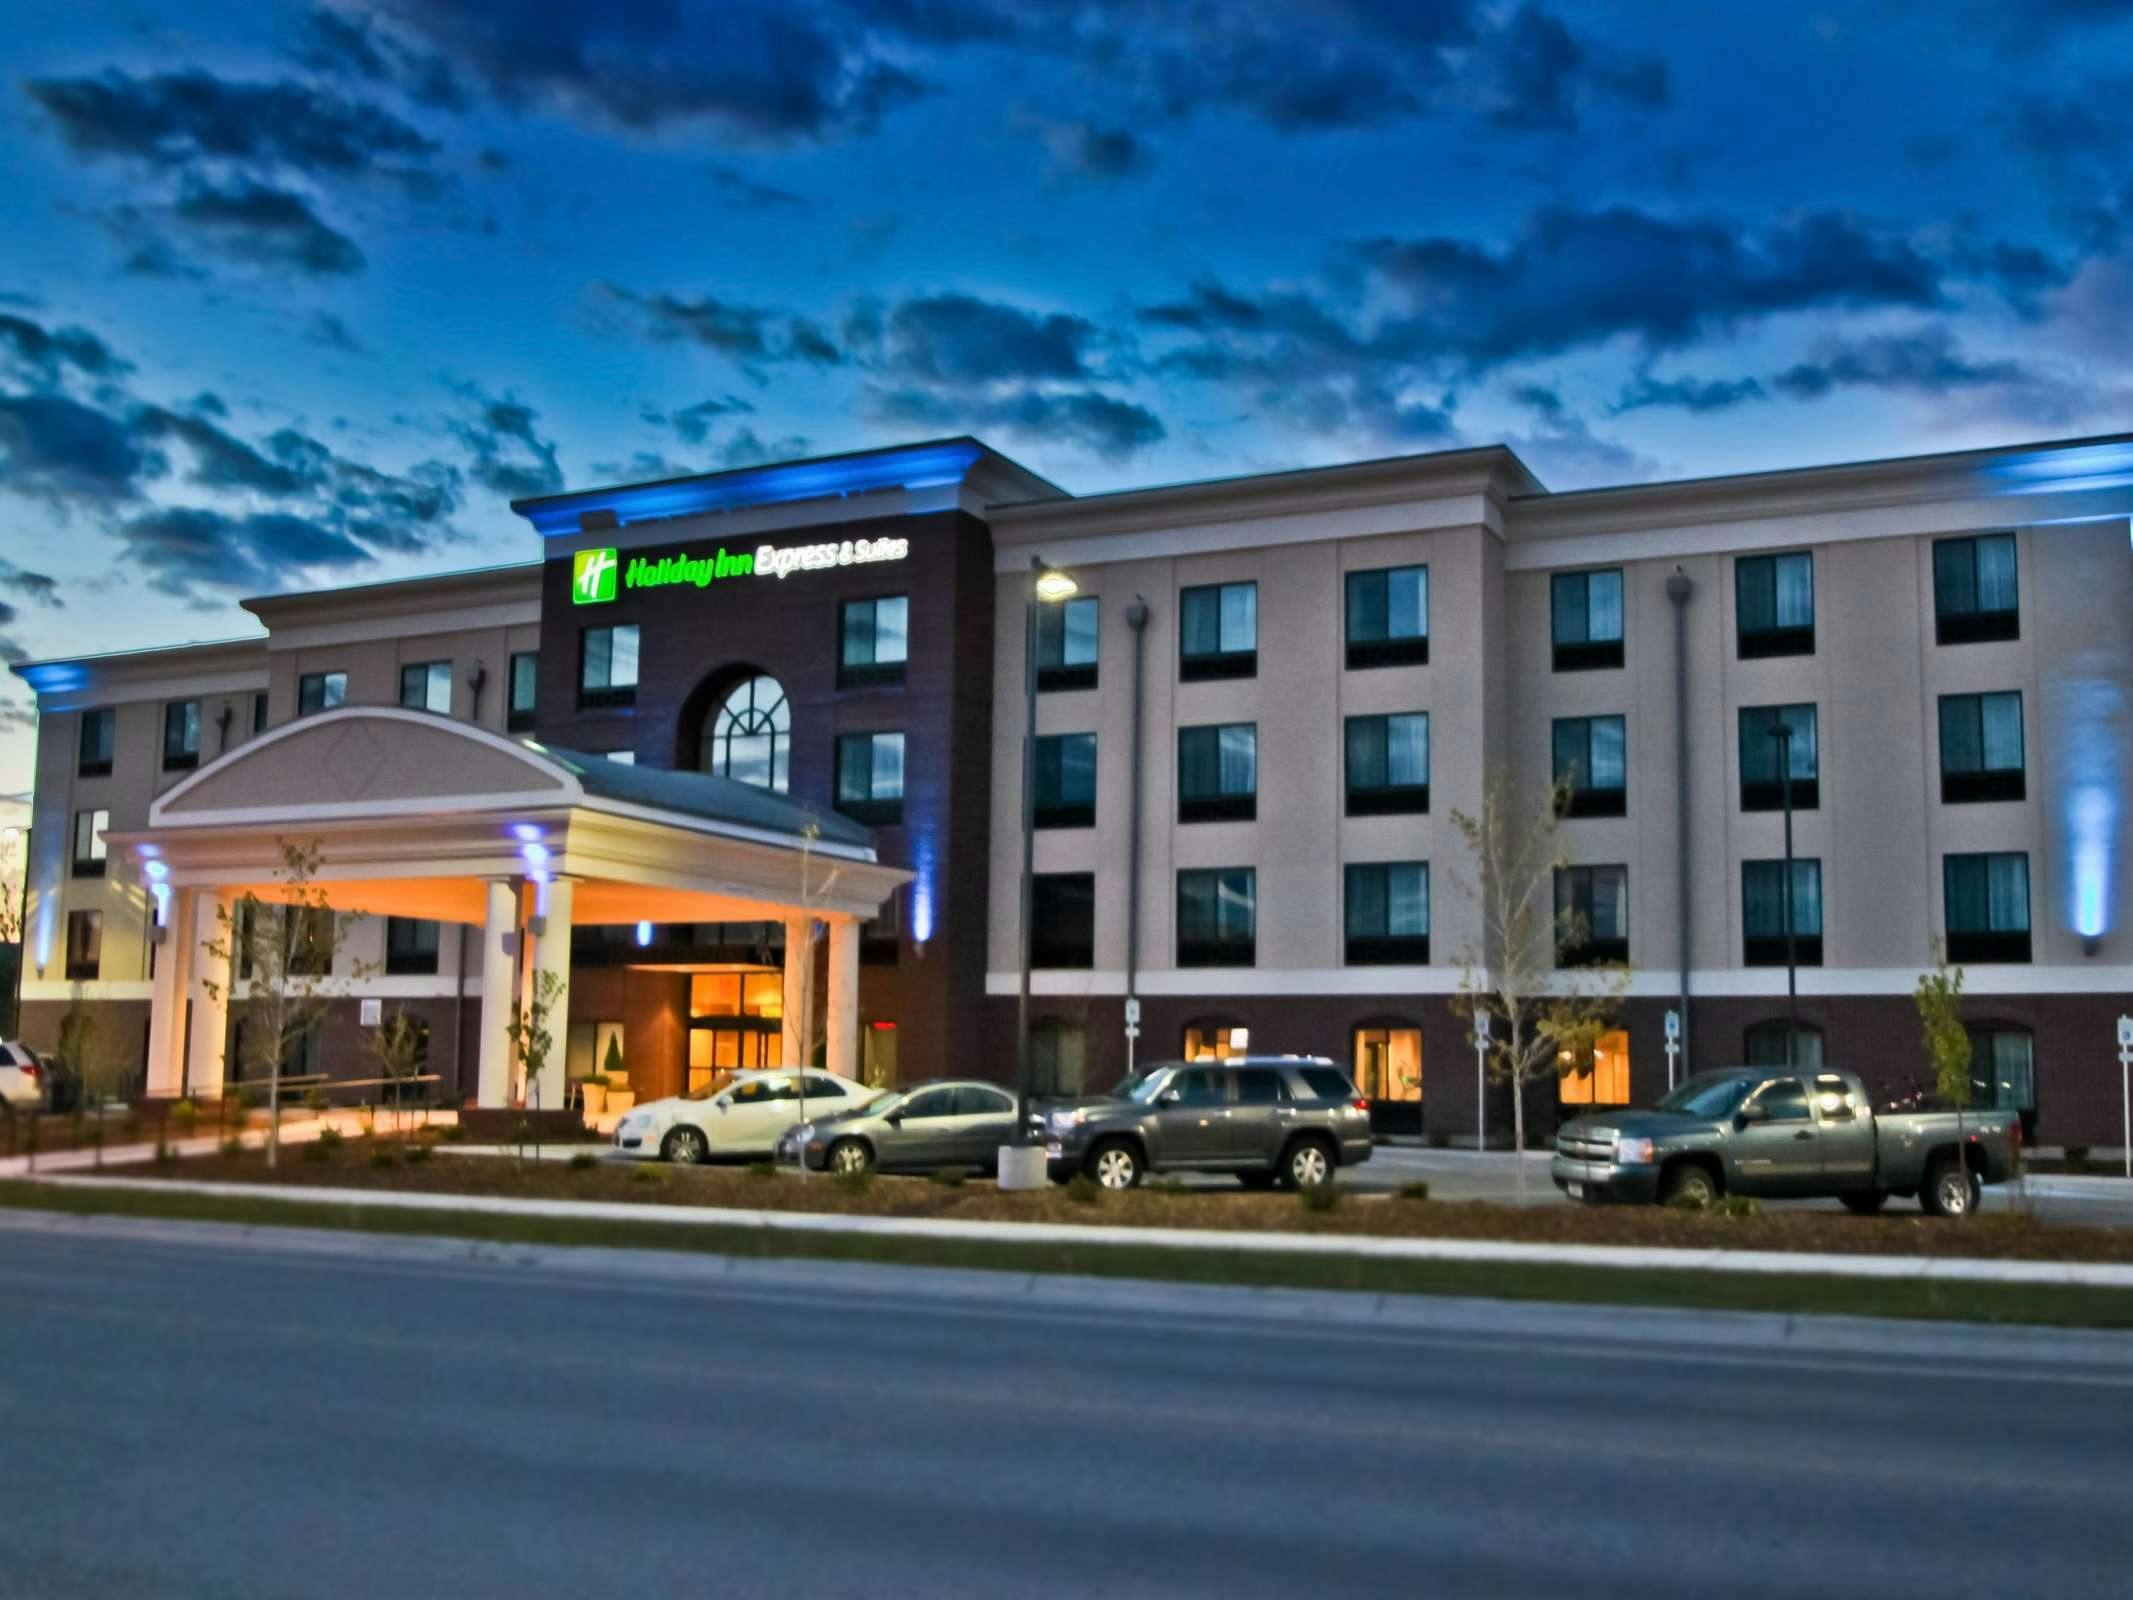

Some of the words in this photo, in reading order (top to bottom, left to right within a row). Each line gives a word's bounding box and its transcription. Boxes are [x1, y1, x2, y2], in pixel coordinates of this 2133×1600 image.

[626, 554, 713, 587] Holiday
[715, 548, 752, 577] Inn
[754, 542, 838, 578] Express
[838, 541, 853, 565] &
[854, 538, 908, 562] Suites
